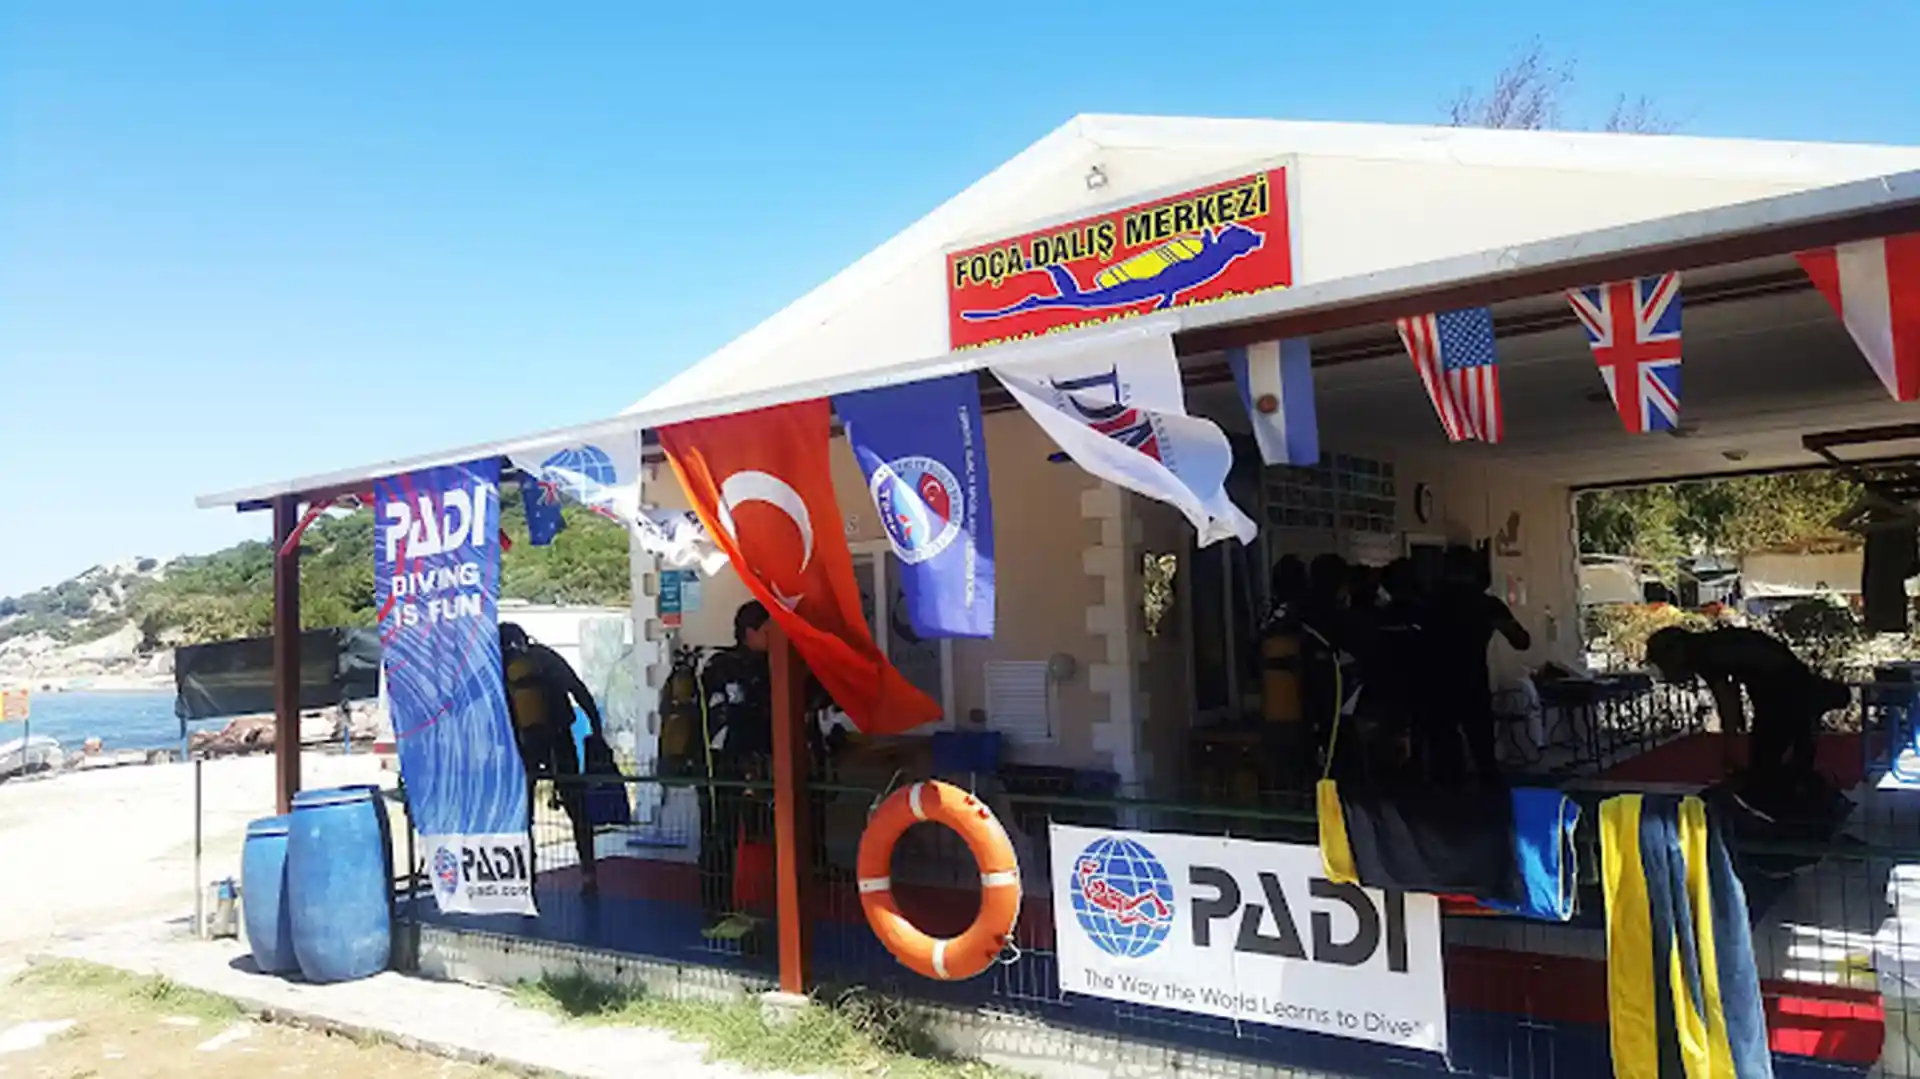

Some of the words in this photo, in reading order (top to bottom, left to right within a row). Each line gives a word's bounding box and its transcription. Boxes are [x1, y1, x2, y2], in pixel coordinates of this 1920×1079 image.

[954, 245, 1024, 287] FOÇA
[1031, 220, 1116, 268] DALIŞ
[1124, 173, 1269, 248] MERKEZİ
[386, 485, 487, 562] PADI
[391, 562, 480, 596] DIVING
[393, 604, 419, 628] IS
[428, 593, 482, 623] FUN
[462, 845, 527, 882] PADI
[1189, 865, 1408, 973] PADI
[1084, 968, 1114, 990] The
[1117, 974, 1160, 1000] Way
[1165, 983, 1196, 1002] the
[1200, 987, 1257, 1012] World
[1262, 997, 1330, 1025] Learns
[1337, 1010, 1359, 1029] to
